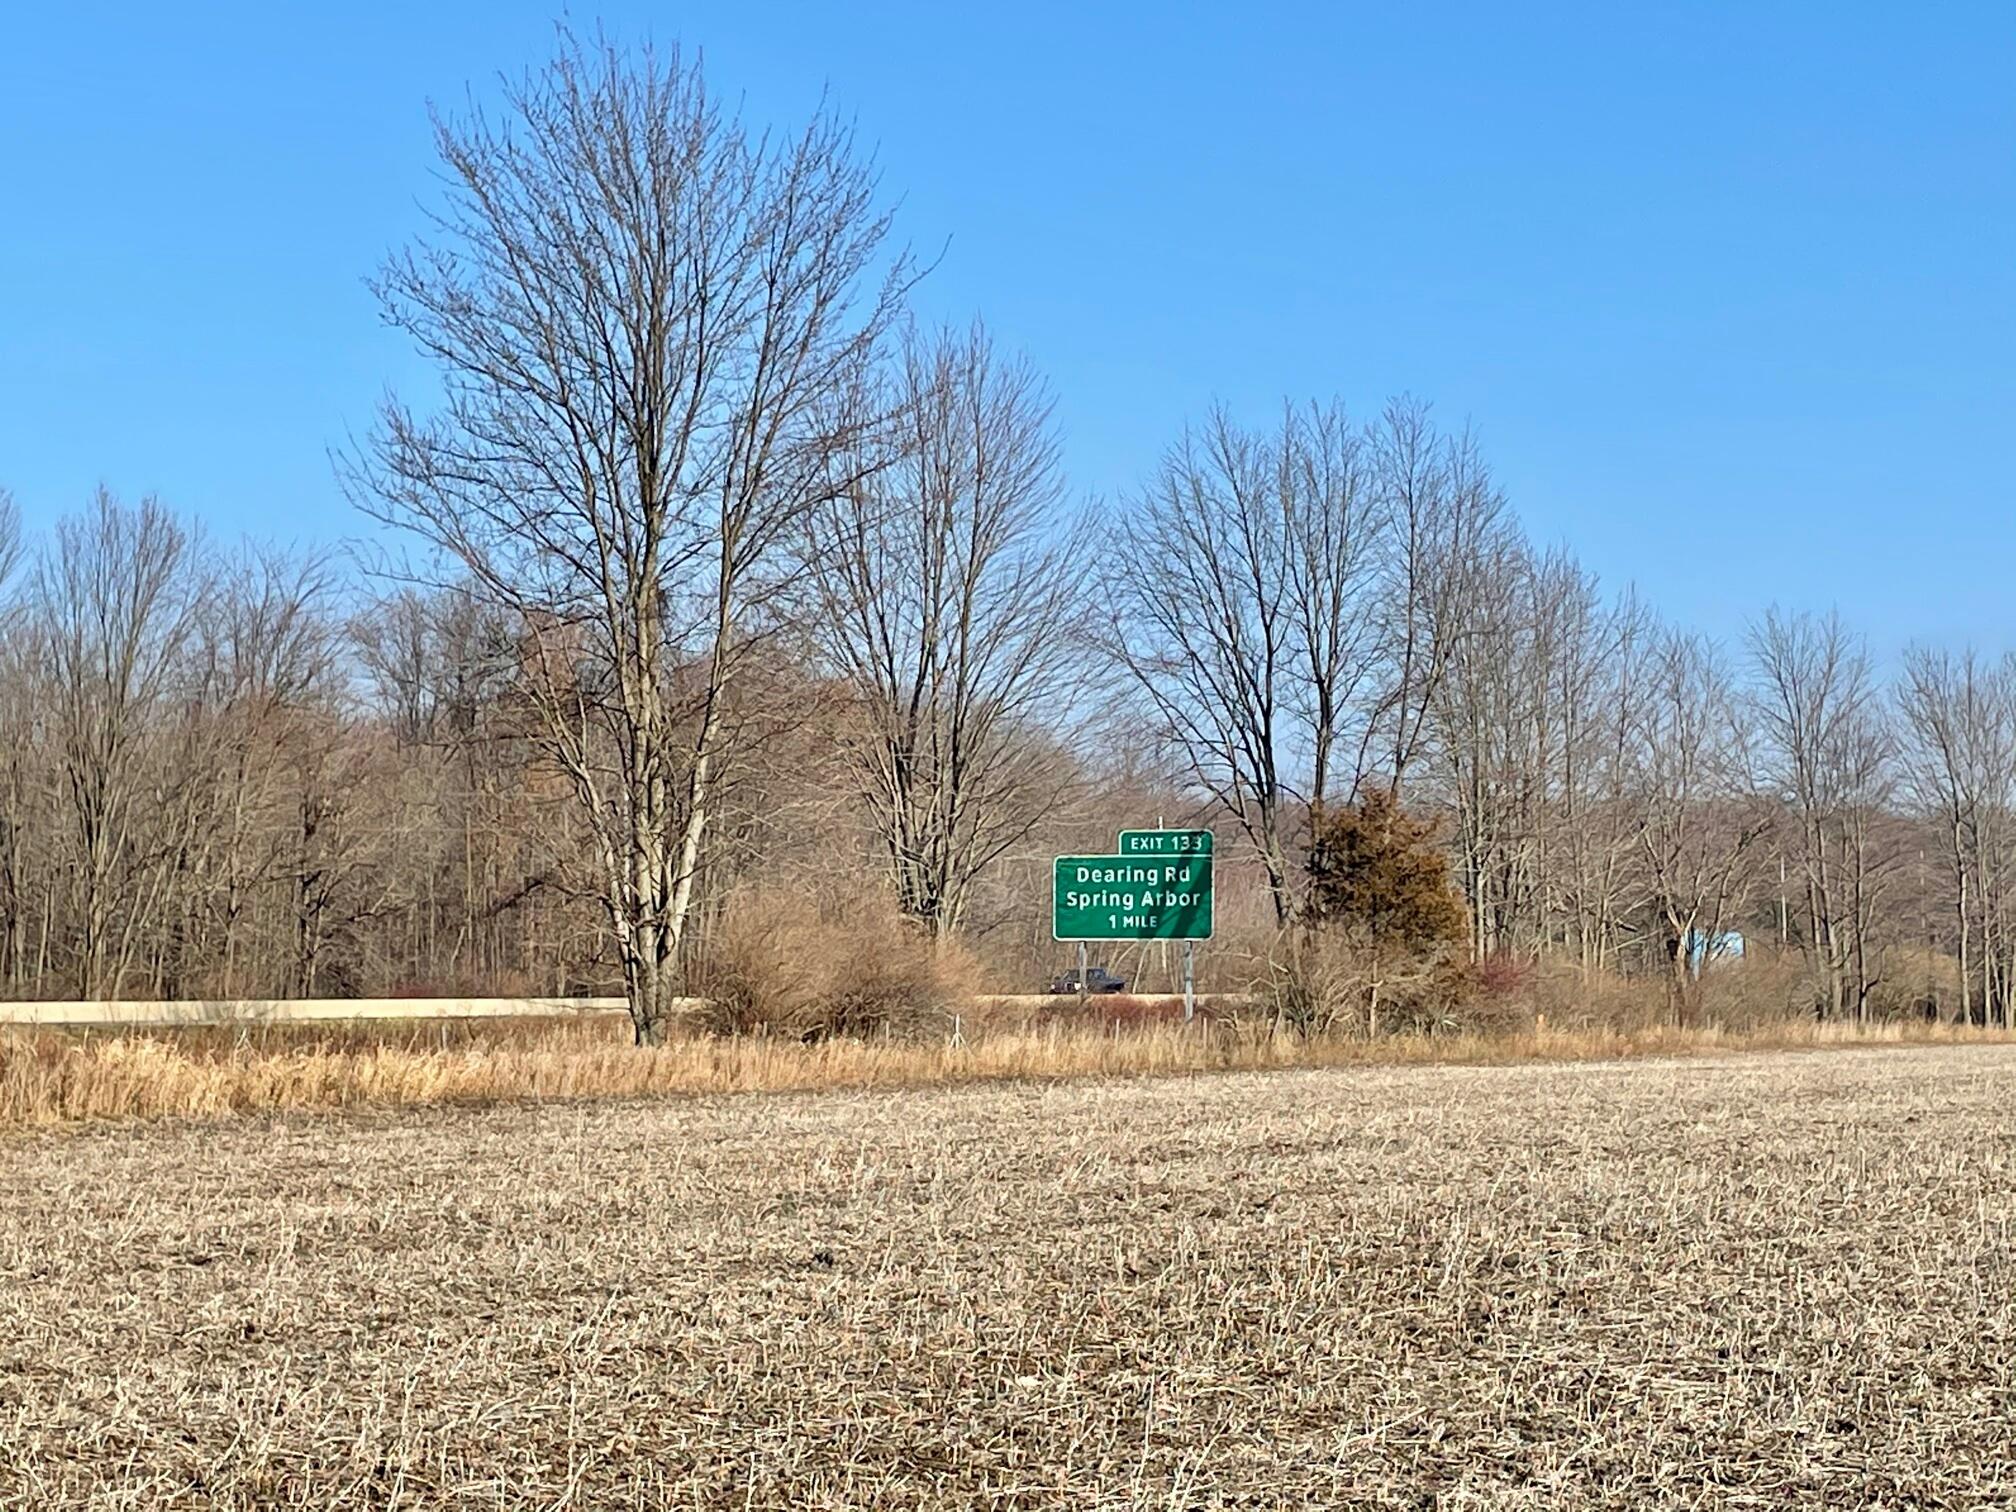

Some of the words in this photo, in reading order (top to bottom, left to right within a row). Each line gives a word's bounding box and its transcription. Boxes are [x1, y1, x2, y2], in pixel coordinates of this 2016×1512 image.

[1131, 837, 1164, 850] EXIT
[1171, 836, 1202, 850] 133
[1076, 866, 1158, 886] Dearing
[1165, 866, 1190, 882] Rd
[1066, 890, 1134, 910] Spring
[1141, 890, 1200, 907] Arbor
[1109, 915, 1116, 929] 1
[1123, 916, 1157, 928] MILE
